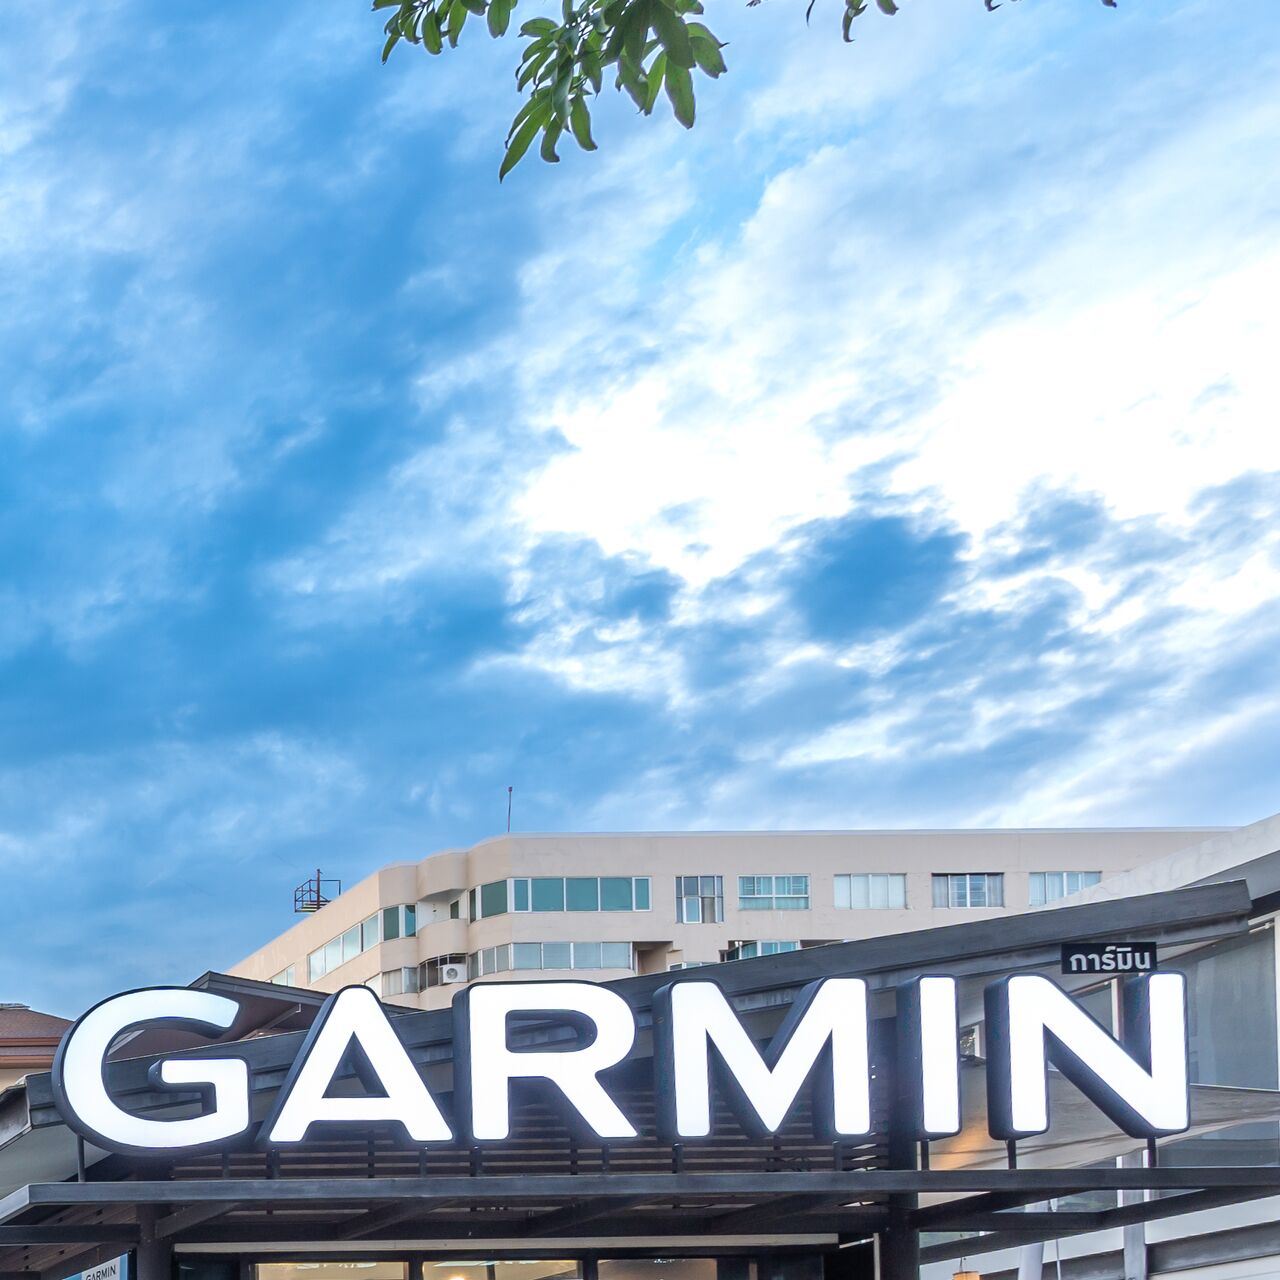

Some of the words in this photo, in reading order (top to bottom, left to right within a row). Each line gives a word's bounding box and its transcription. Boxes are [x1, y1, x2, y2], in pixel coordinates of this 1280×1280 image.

[1070, 946, 1151, 971] การ์มิน
[54, 974, 1190, 1152] GARMIN
